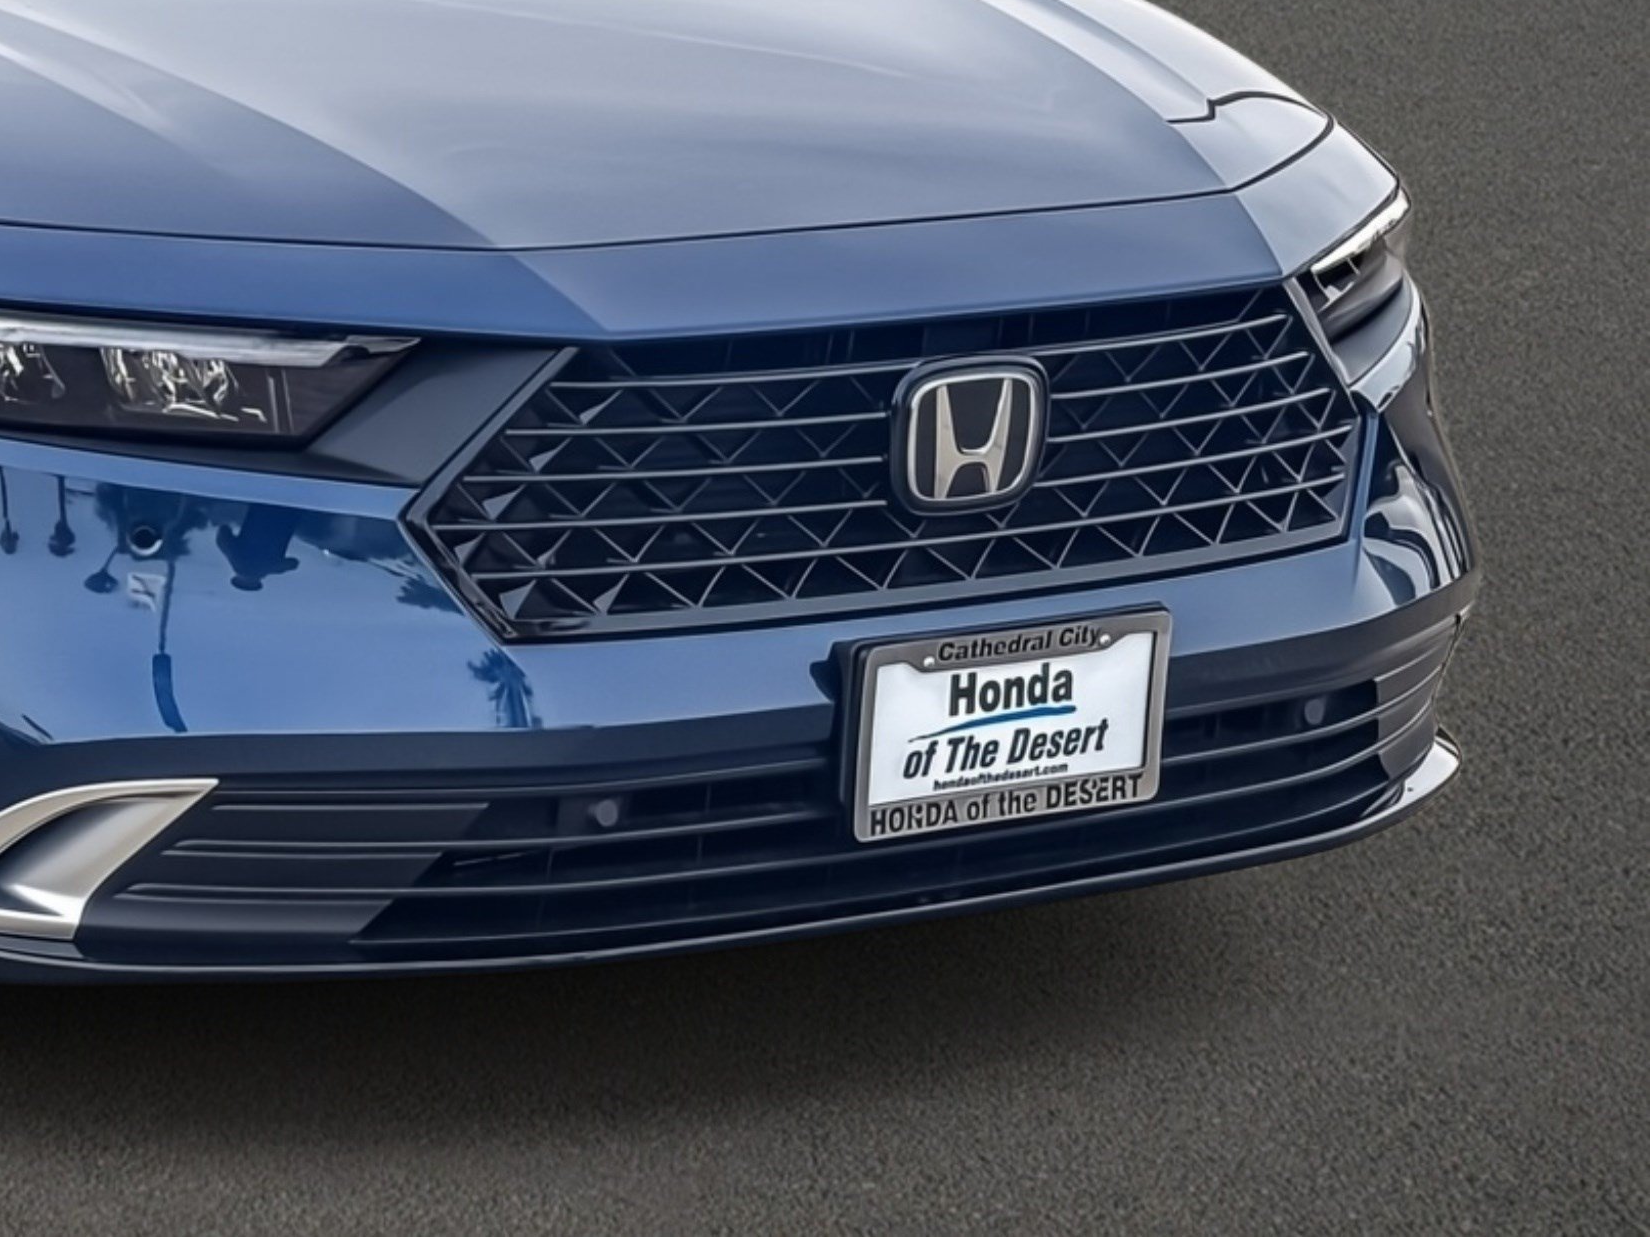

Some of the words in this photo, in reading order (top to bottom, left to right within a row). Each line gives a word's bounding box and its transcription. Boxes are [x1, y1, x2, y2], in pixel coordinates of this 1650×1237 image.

[938, 631, 1051, 661] Cathedral
[1058, 625, 1101, 648] City
[948, 662, 1073, 717] Honda
[903, 740, 938, 779] of
[945, 736, 998, 774] The
[1007, 718, 1109, 763] Desert
[932, 763, 1069, 791] hondaofthedesert.com
[869, 800, 958, 837] HONDA
[966, 796, 991, 821] of
[999, 788, 1037, 816] the
[1045, 773, 1144, 809] DESERT
